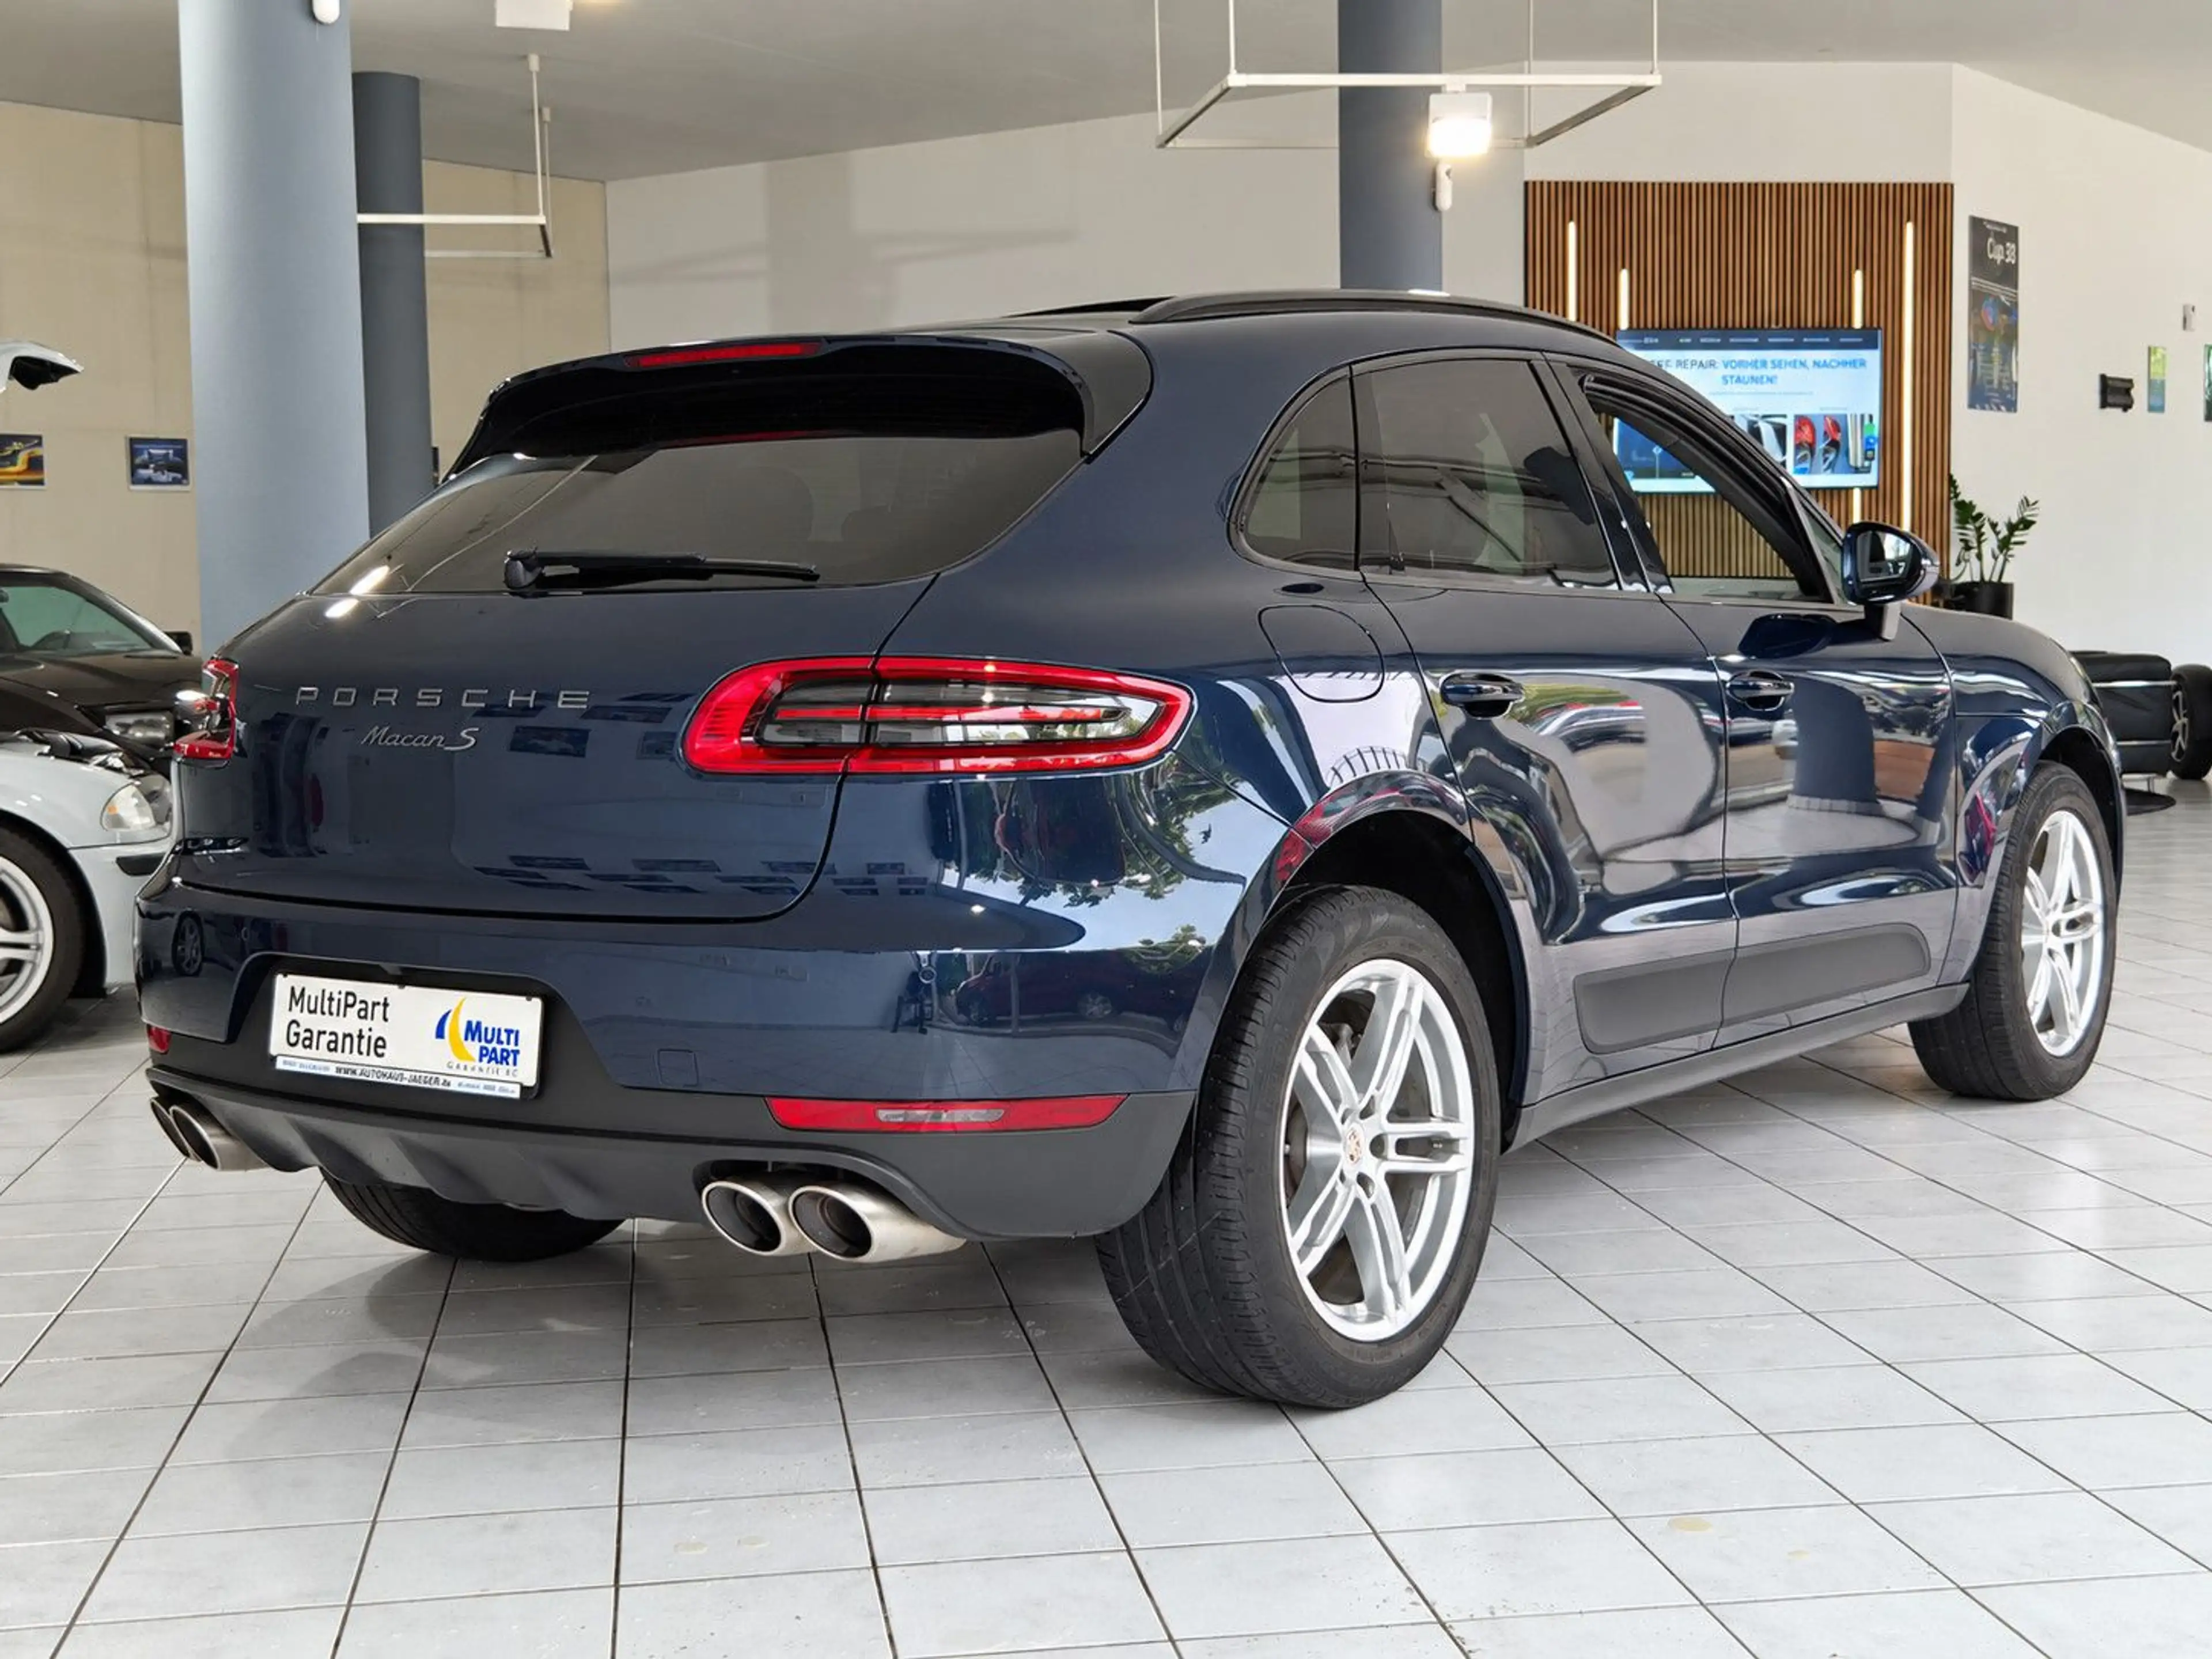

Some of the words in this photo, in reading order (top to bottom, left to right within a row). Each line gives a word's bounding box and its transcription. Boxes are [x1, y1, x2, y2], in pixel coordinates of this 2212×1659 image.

[296, 686, 590, 709] PORSCHE
[361, 725, 445, 747] Macan
[444, 727, 480, 751] S
[288, 985, 390, 1022] MultiPart
[286, 1019, 387, 1058] Garantie
[478, 1045, 520, 1067] PART
